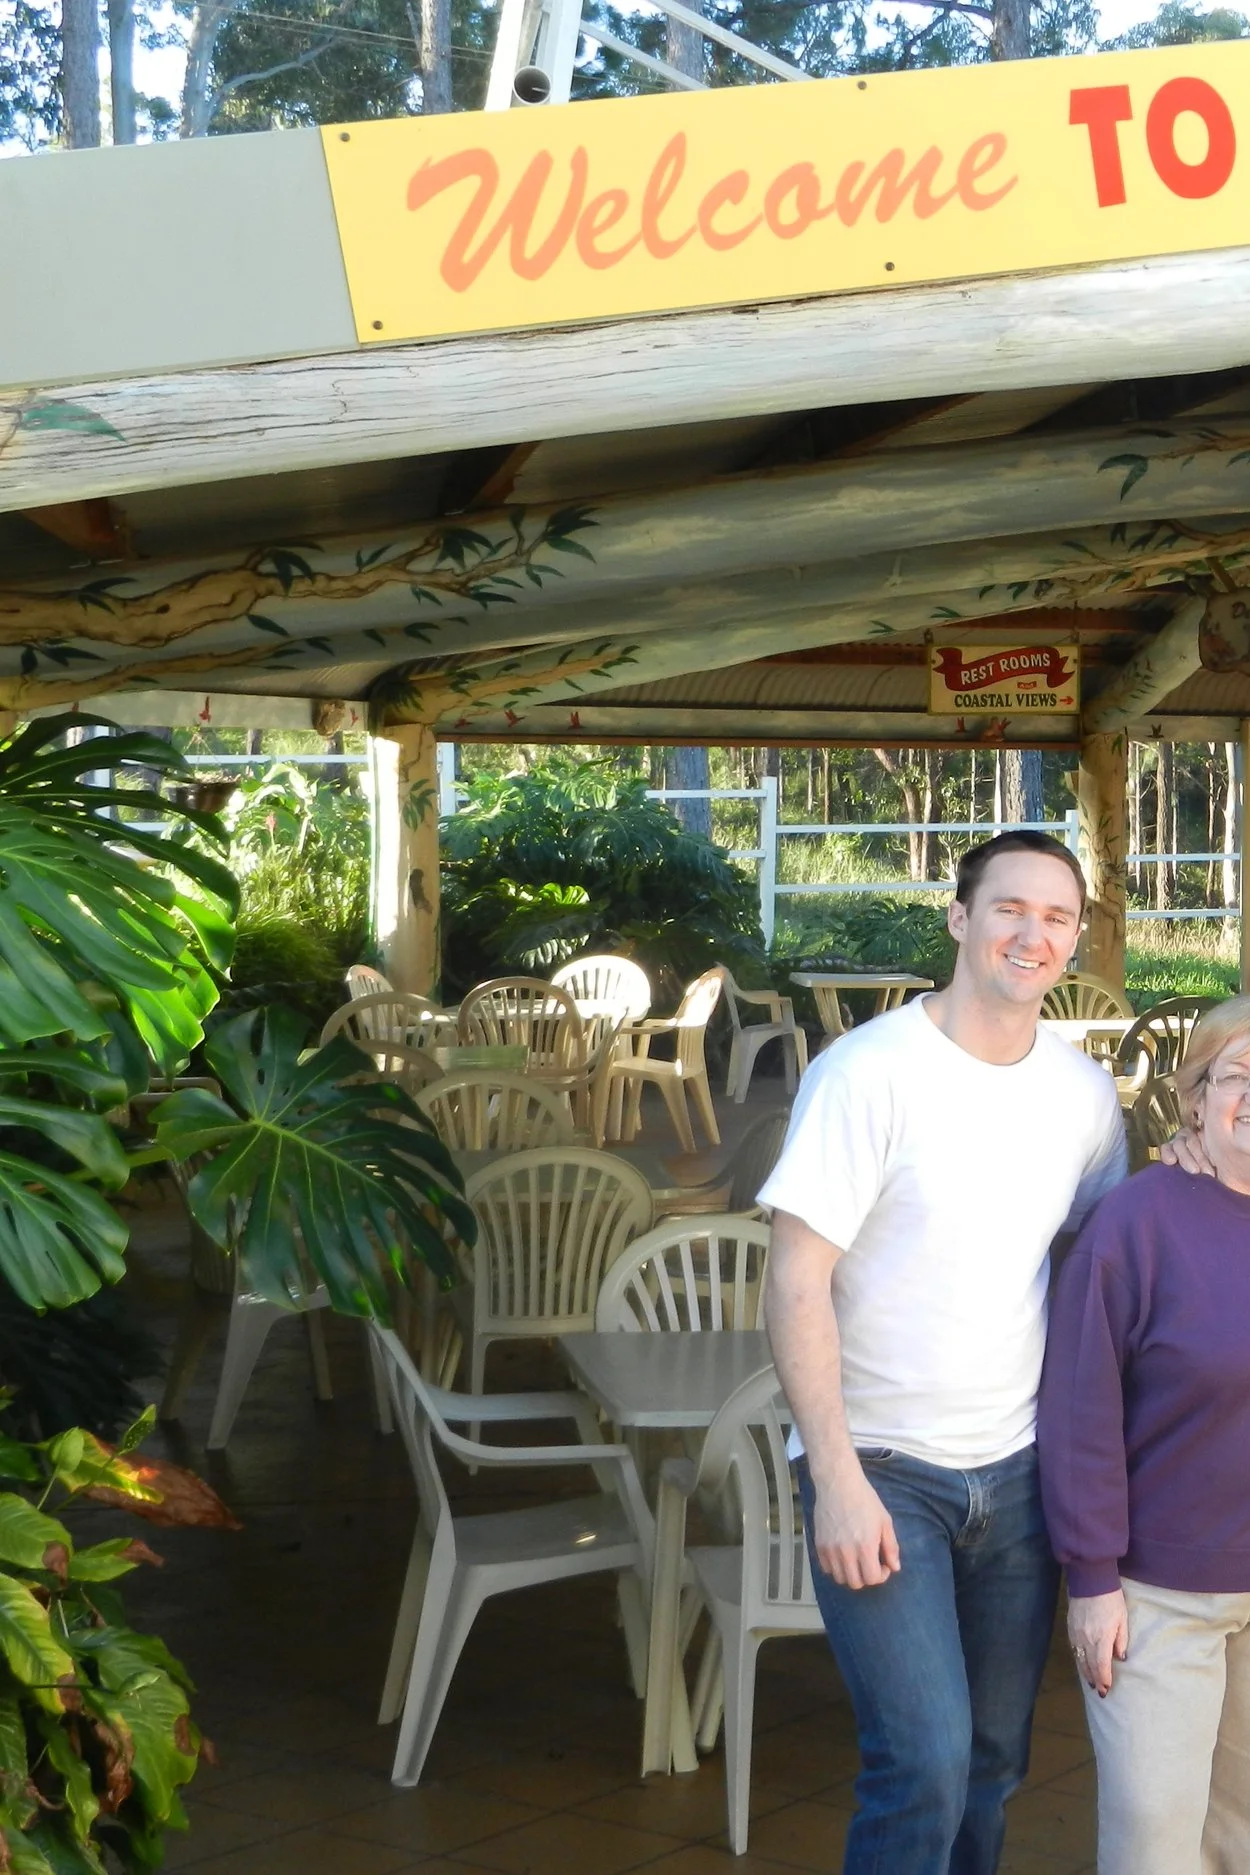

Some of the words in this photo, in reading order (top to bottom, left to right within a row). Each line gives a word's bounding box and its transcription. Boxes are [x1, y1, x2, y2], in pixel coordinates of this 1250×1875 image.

[406, 131, 1019, 293] Welcome
[1068, 76, 1237, 208] TO
[961, 662, 995, 685] REST
[1000, 653, 1050, 673] ROOMS
[954, 693, 1012, 708] COASTAL
[1016, 693, 1057, 707] VIEWS
